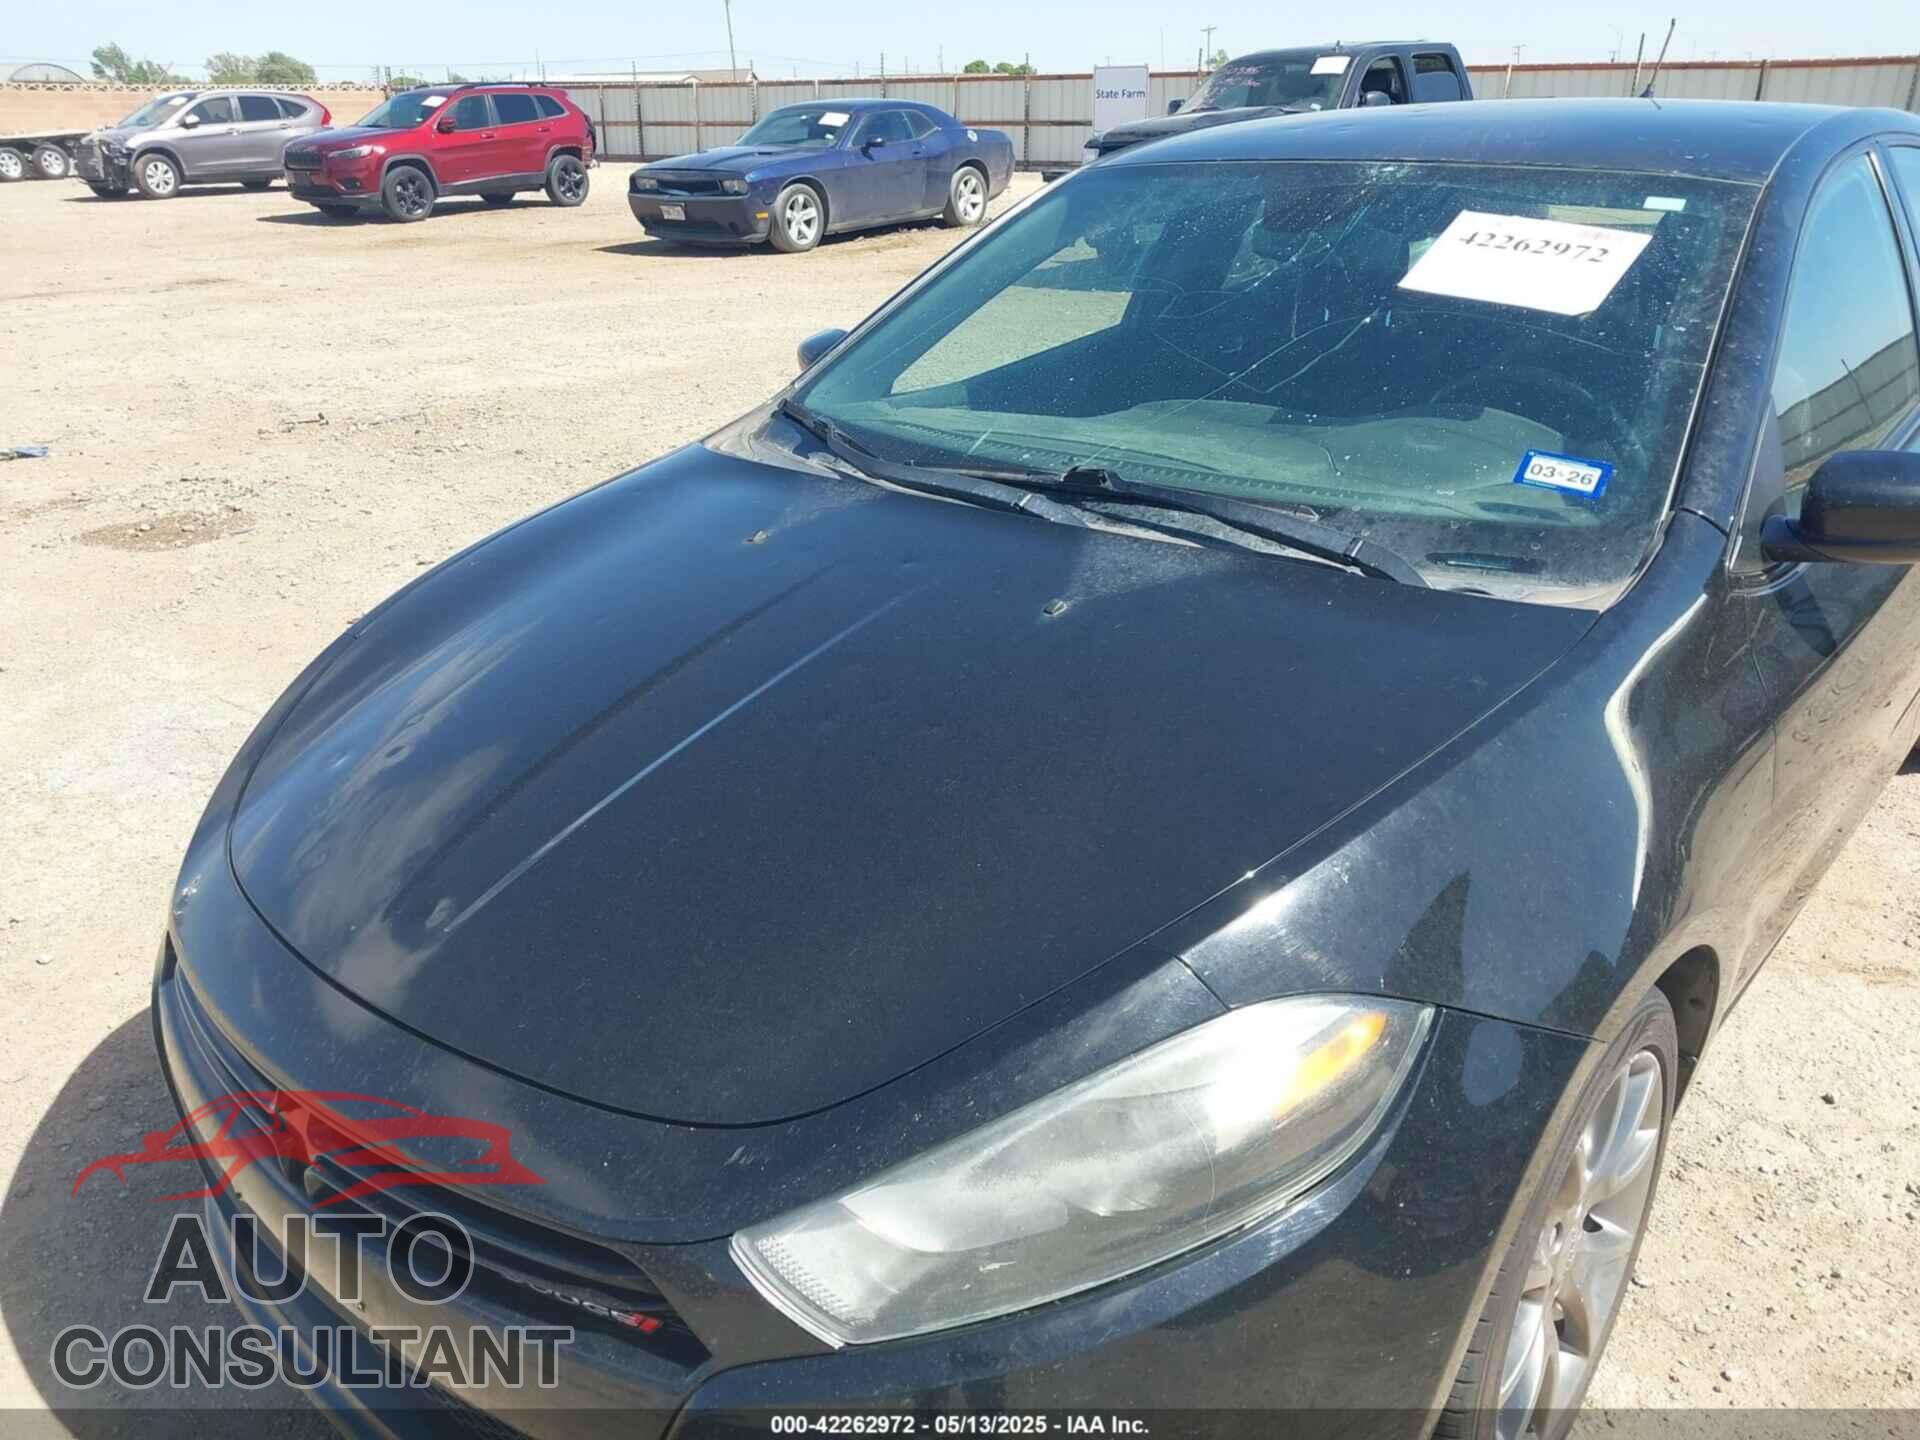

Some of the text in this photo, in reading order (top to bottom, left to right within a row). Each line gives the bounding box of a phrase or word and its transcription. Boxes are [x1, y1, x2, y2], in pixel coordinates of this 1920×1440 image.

[1096, 88, 1146, 100] State Farm
[1459, 231, 1609, 263] 42262972
[1530, 463, 1556, 478] 03
[1566, 470, 1593, 485] 26
